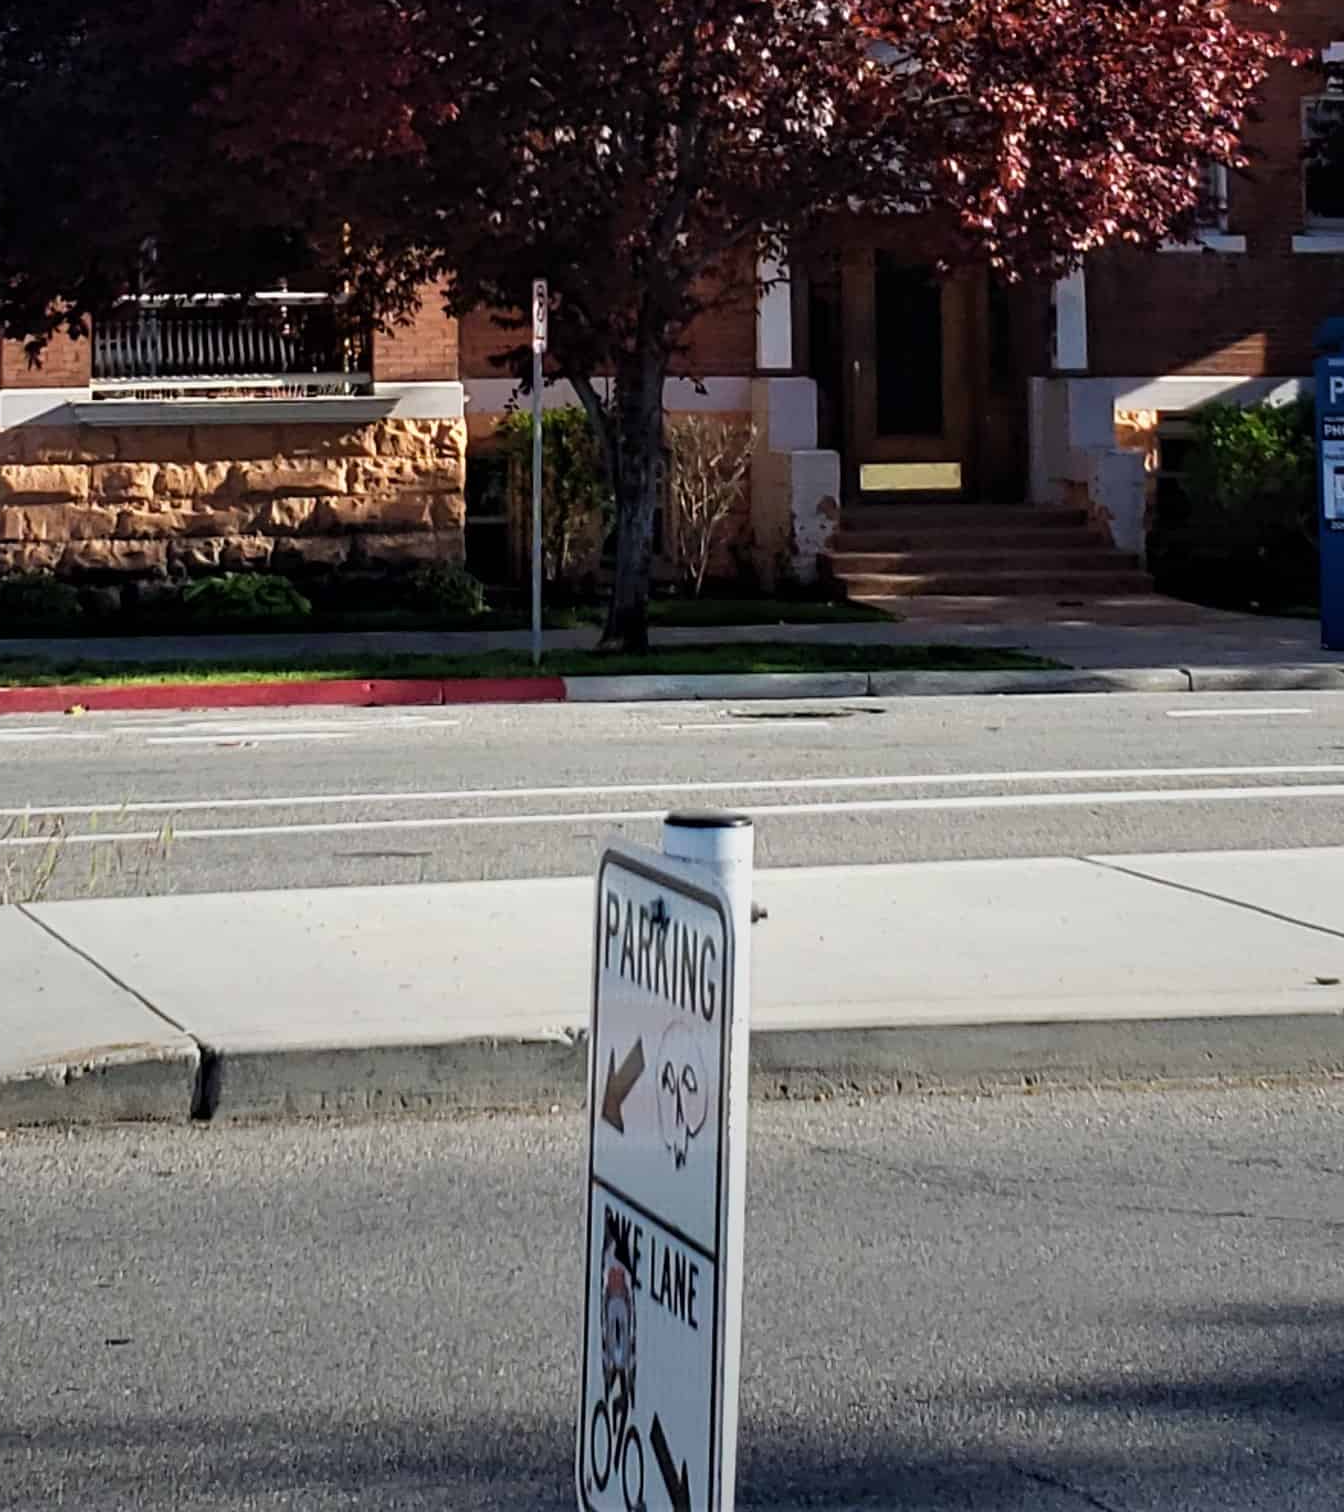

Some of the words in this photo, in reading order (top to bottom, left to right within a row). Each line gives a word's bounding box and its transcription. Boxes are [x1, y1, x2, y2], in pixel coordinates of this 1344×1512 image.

[604, 889, 716, 1022] PARKING
[603, 1203, 644, 1292] KE
[650, 1234, 700, 1331] LANE
